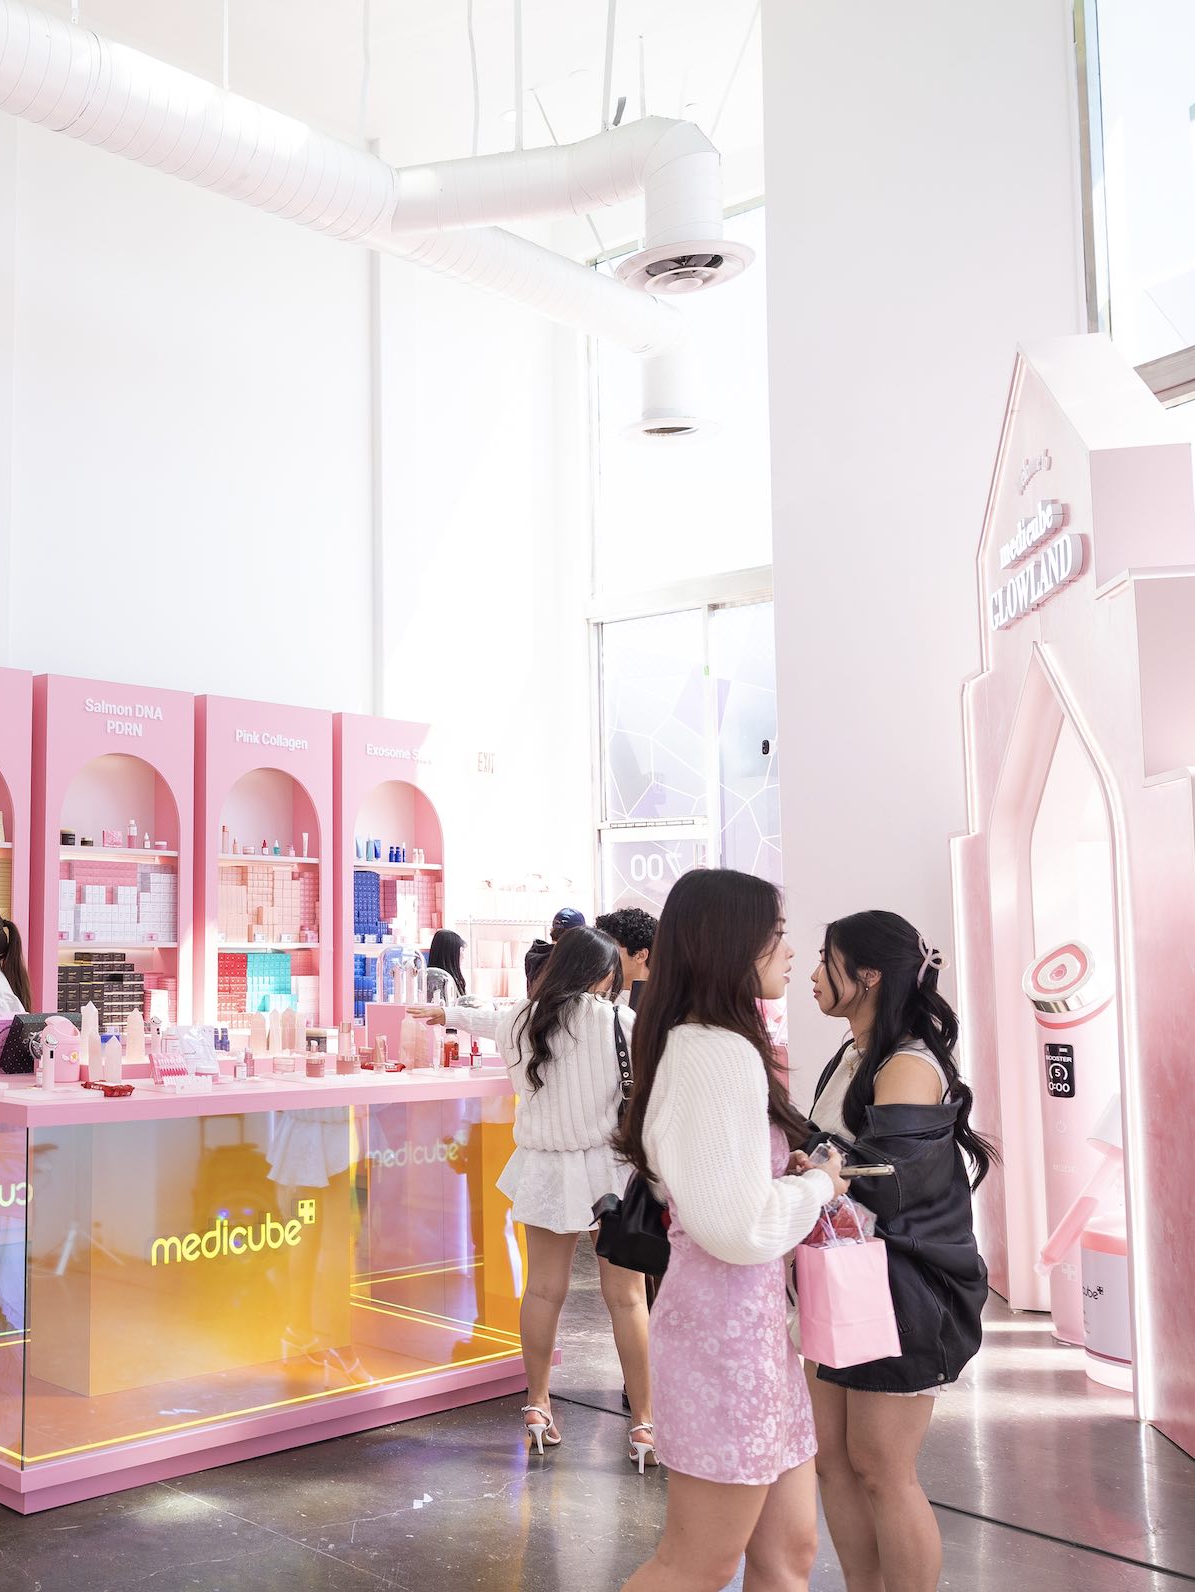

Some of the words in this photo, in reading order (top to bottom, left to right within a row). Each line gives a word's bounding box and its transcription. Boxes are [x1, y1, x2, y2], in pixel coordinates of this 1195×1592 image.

[1000, 500, 1061, 569] medicube
[990, 534, 1079, 631] GLOWLAND
[85, 698, 133, 717] Salmon
[134, 704, 163, 721] DNA
[106, 720, 143, 737] PDRN
[235, 730, 260, 746] Pink
[261, 733, 308, 752] Collagen
[366, 744, 411, 759] Exosome
[1055, 1069, 1061, 1077] 5
[365, 1136, 459, 1168] medicube
[151, 1215, 303, 1267] medicube
